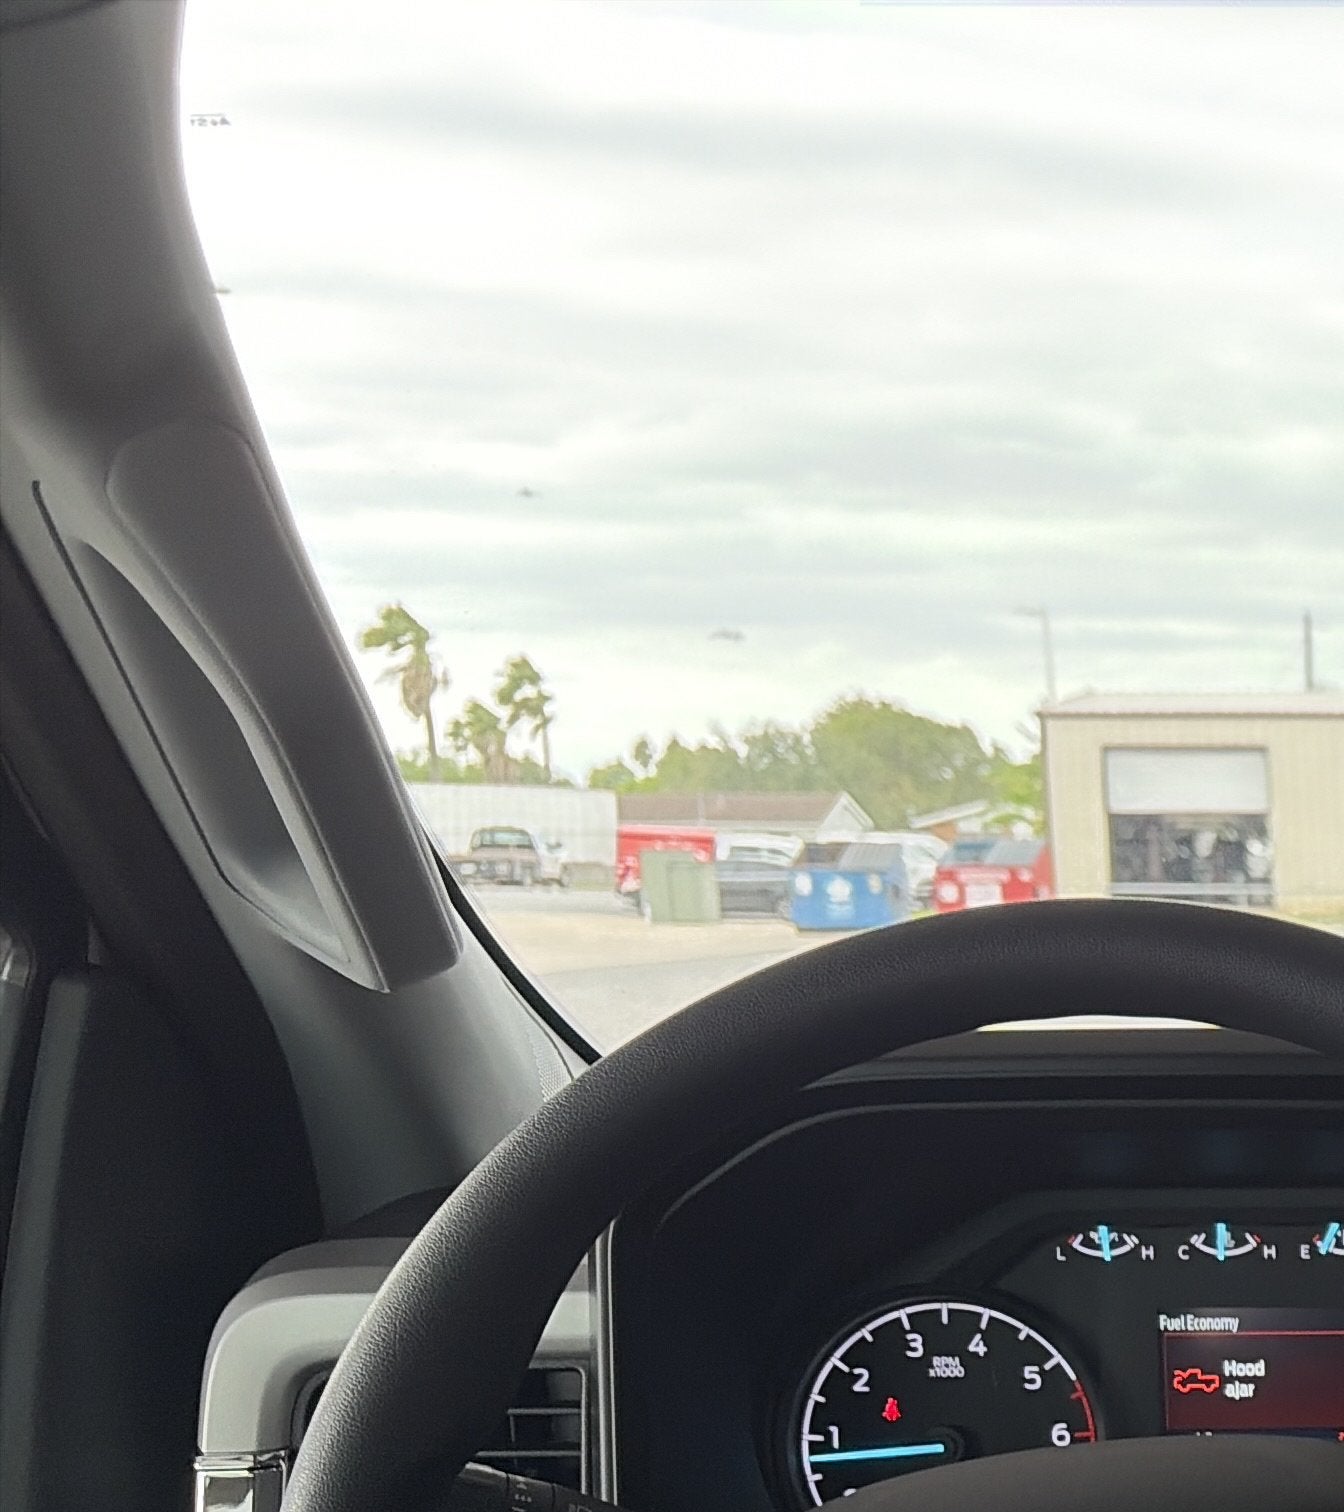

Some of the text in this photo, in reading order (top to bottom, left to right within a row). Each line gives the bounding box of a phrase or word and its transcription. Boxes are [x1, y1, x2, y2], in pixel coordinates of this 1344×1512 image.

[1056, 1246, 1066, 1261] L
[1142, 1244, 1154, 1260] H
[1178, 1245, 1189, 1260] C
[1264, 1245, 1276, 1260] H
[1301, 1244, 1310, 1260] E
[1159, 1314, 1239, 1333] Fuel Economy
[905, 1333, 924, 1358] 3
[968, 1333, 987, 1357] 4
[932, 1356, 960, 1368] RPM
[1223, 1359, 1265, 1377] Hood
[853, 1368, 870, 1392] 2
[1023, 1366, 1042, 1391] 5
[1224, 1381, 1255, 1400] ajar
[828, 1426, 839, 1449] 1
[1051, 1423, 1071, 1447] 6
